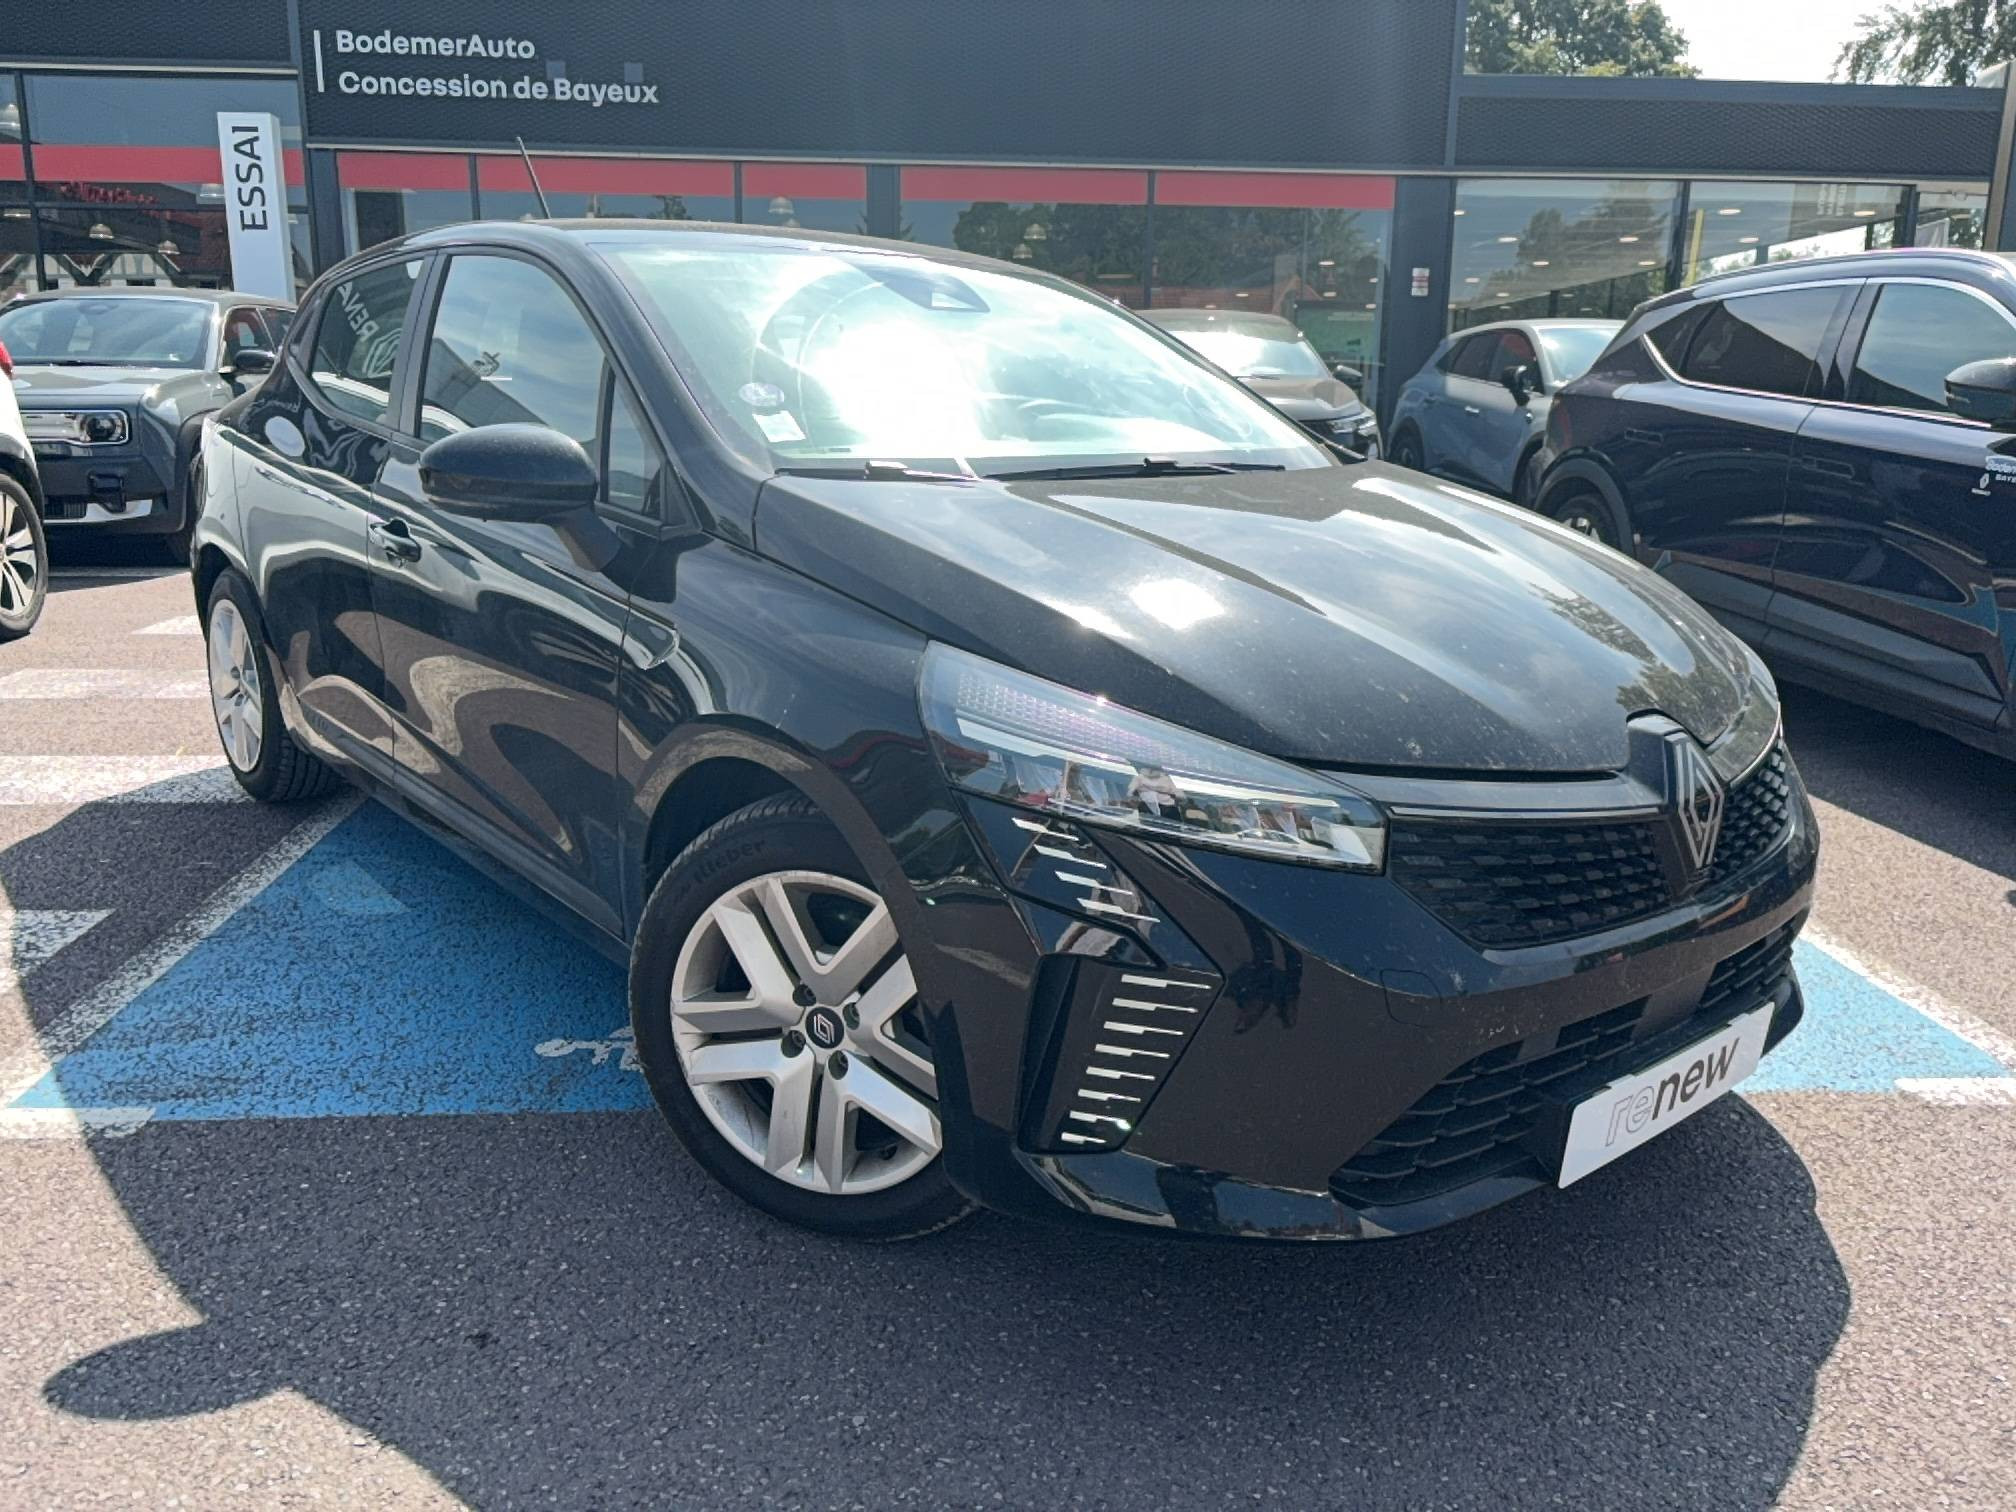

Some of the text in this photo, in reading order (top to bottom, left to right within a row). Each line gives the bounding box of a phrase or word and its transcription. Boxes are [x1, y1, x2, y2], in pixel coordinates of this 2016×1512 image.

[336, 30, 535, 58] BodemerAuto
[338, 71, 659, 106] Concession de Bayeux
[232, 126, 268, 231] ESSAI
[1605, 1037, 1740, 1148] renew
